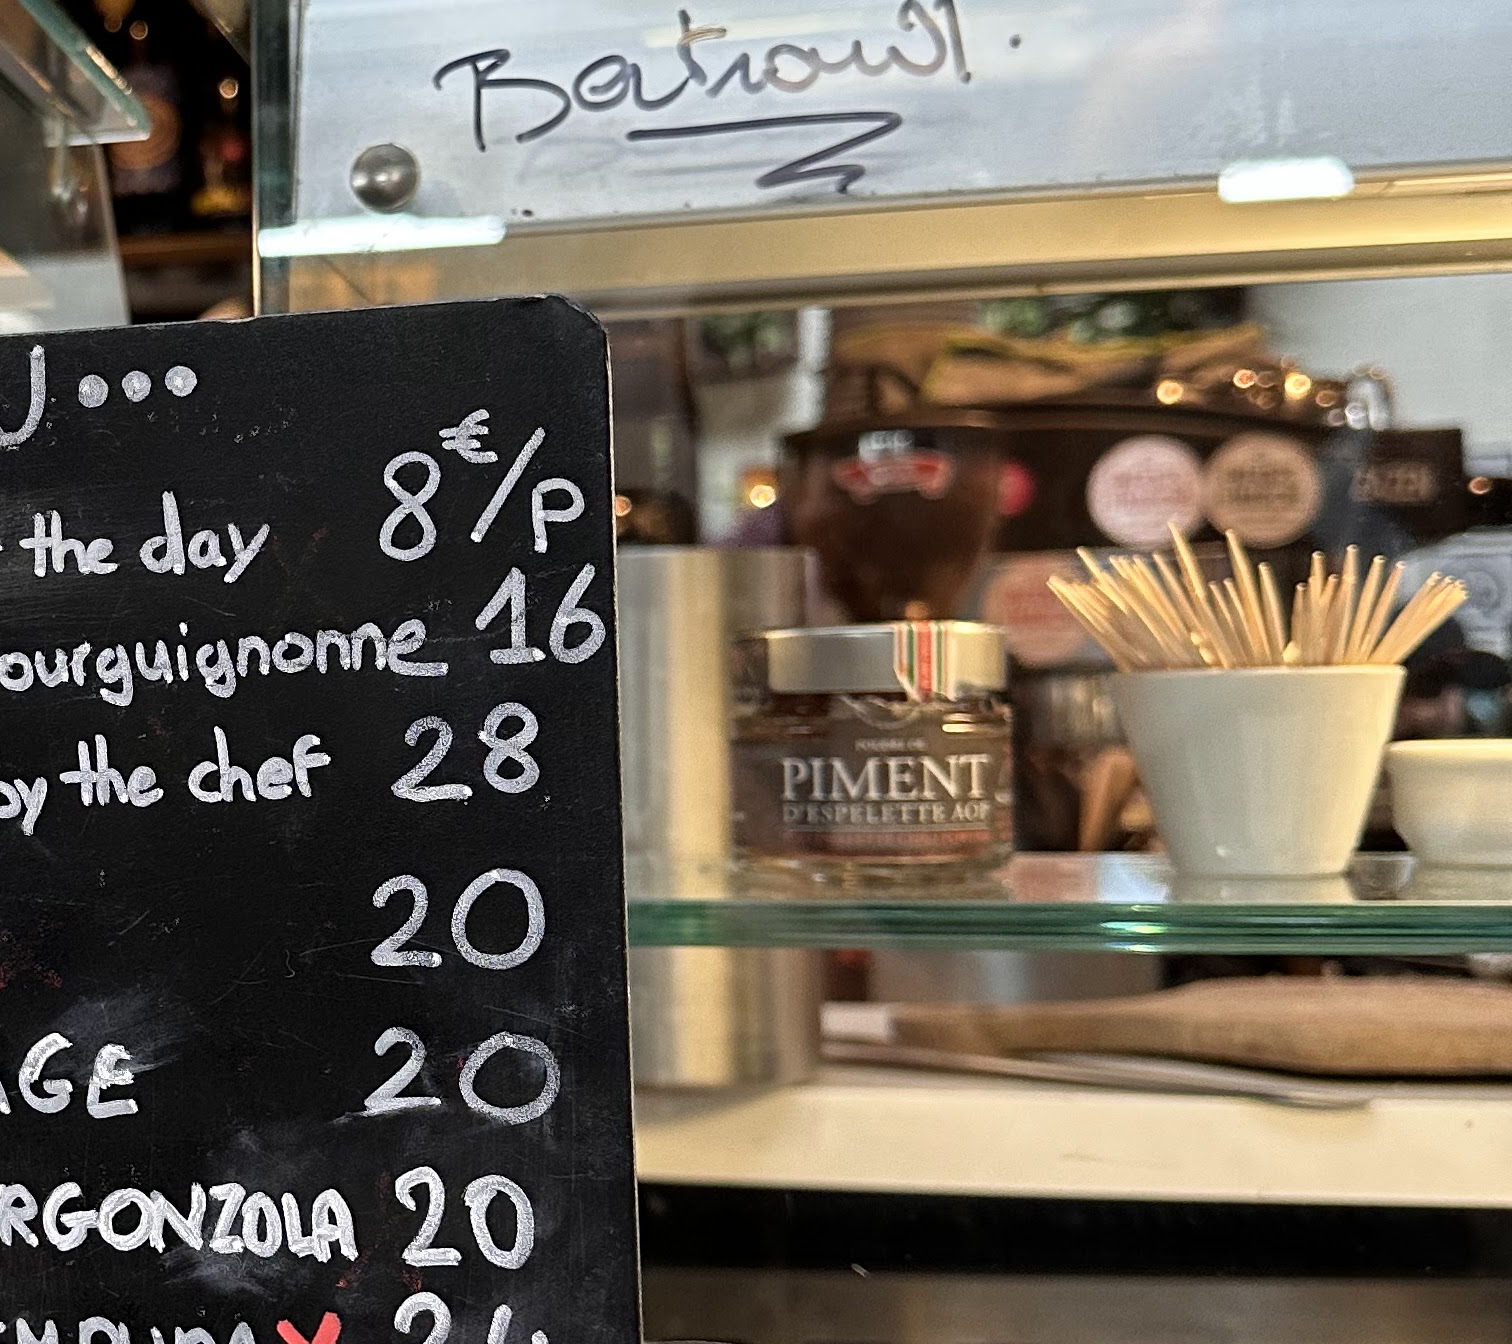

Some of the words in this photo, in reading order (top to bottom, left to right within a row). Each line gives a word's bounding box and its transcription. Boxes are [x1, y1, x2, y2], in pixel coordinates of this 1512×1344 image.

[18, 511, 119, 578] the
[139, 490, 271, 584] day
[475, 564, 607, 666] 16
[59, 734, 164, 808] the
[187, 726, 331, 805] chef
[391, 701, 541, 806] 28
[779, 752, 994, 803] PIMENT
[370, 867, 546, 971] 20
[363, 1026, 561, 1125] 20
[394, 1165, 535, 1270] 20
